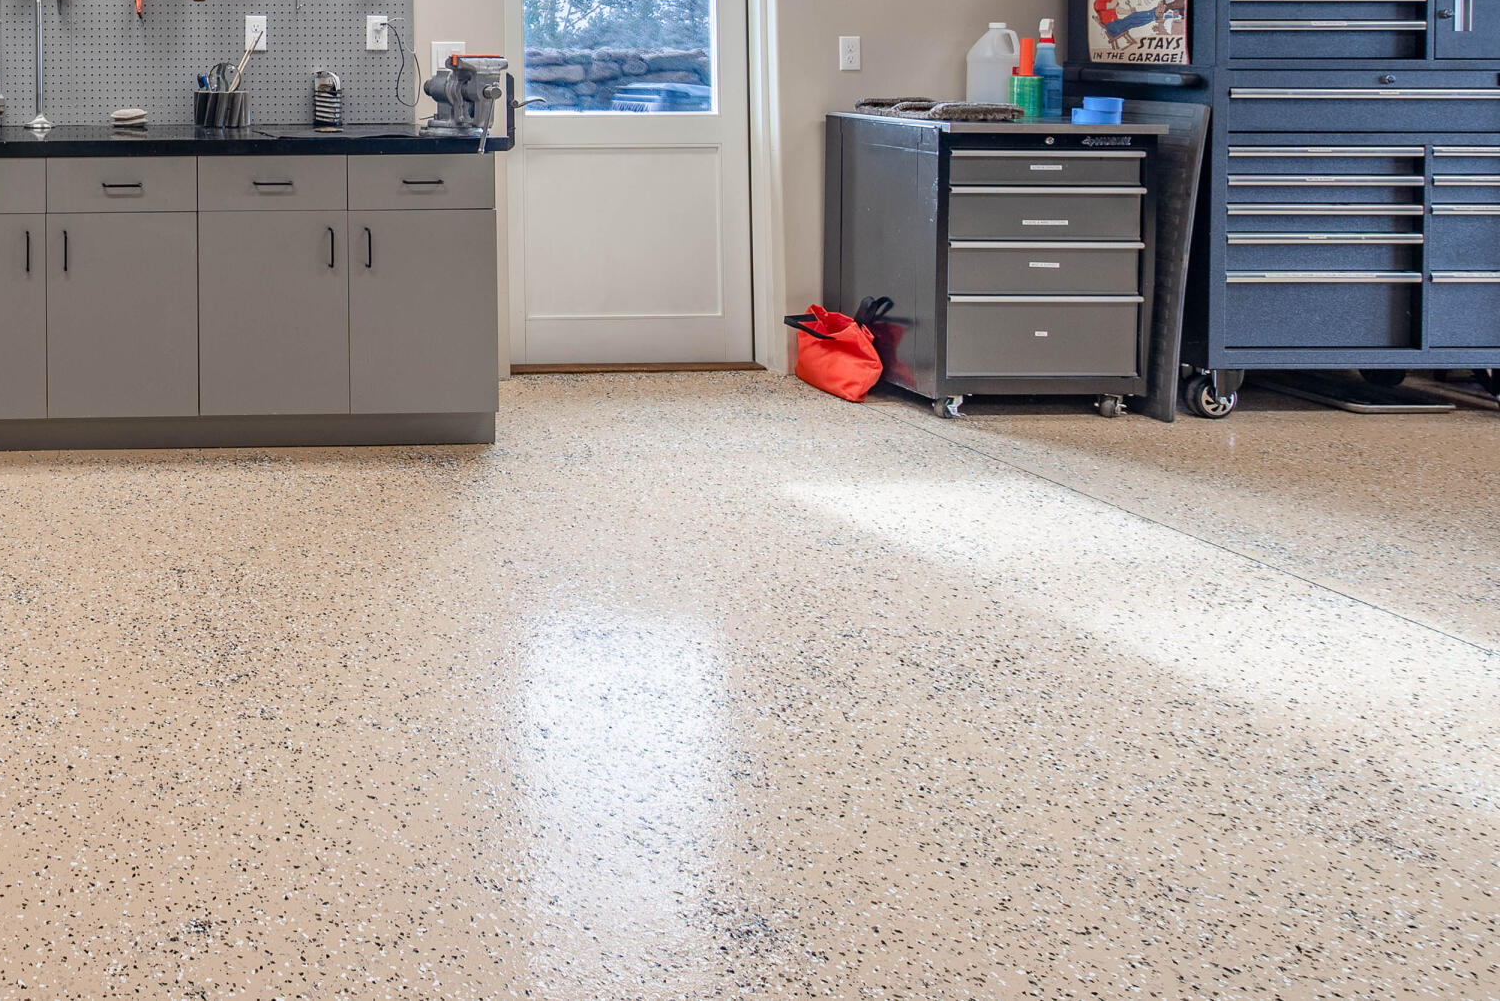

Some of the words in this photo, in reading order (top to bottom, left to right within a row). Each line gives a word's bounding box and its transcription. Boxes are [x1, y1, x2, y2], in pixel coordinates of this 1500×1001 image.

[1137, 37, 1183, 50] STAYS
[1093, 52, 1103, 60] IN
[1106, 52, 1125, 60] THE
[1128, 51, 1184, 63] GARAGE!
